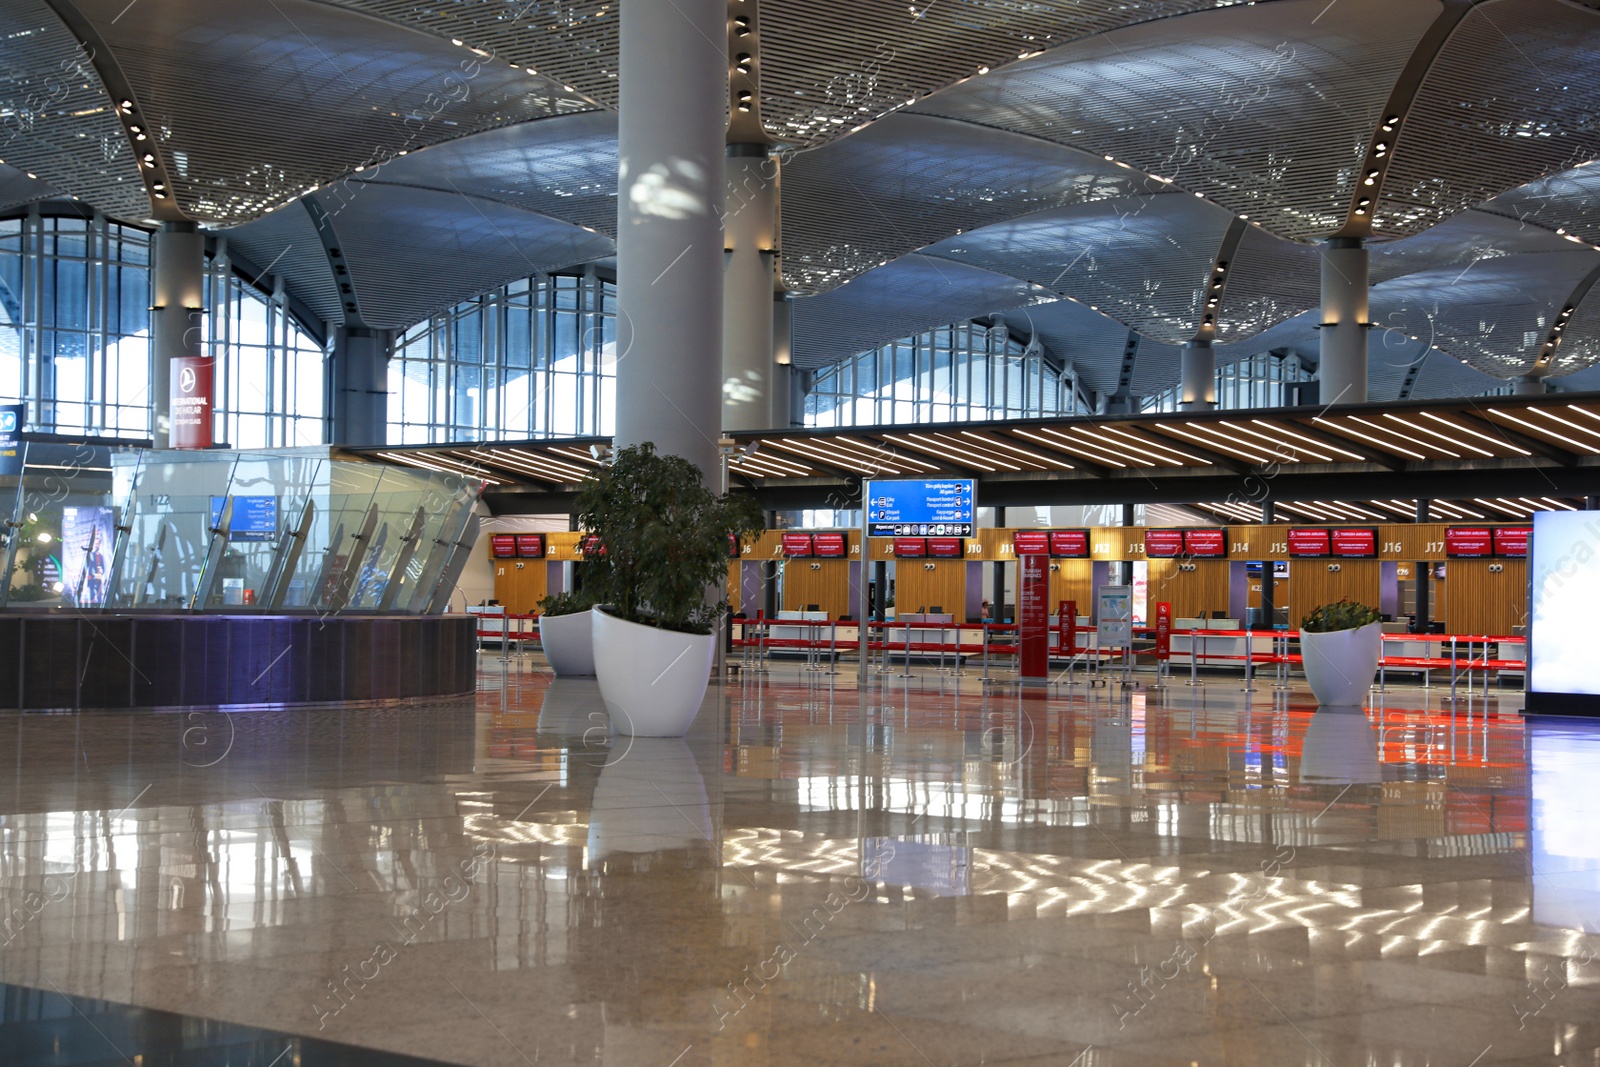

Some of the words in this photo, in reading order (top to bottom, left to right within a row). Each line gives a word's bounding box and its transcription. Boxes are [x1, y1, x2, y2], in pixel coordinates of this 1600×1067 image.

[547, 545, 556, 554] J2
[742, 544, 752, 554] J6
[774, 544, 783, 554] J7
[850, 544, 859, 553] J8
[884, 544, 894, 554] J9
[967, 543, 982, 553] J10
[999, 543, 1014, 554] J11
[1093, 543, 1110, 553] J12
[1128, 543, 1146, 553] J13
[1231, 543, 1249, 553] J14
[1270, 543, 1288, 553] J15
[1383, 542, 1402, 553] J16
[1425, 542, 1444, 553] J17
[497, 567, 505, 576] J1
